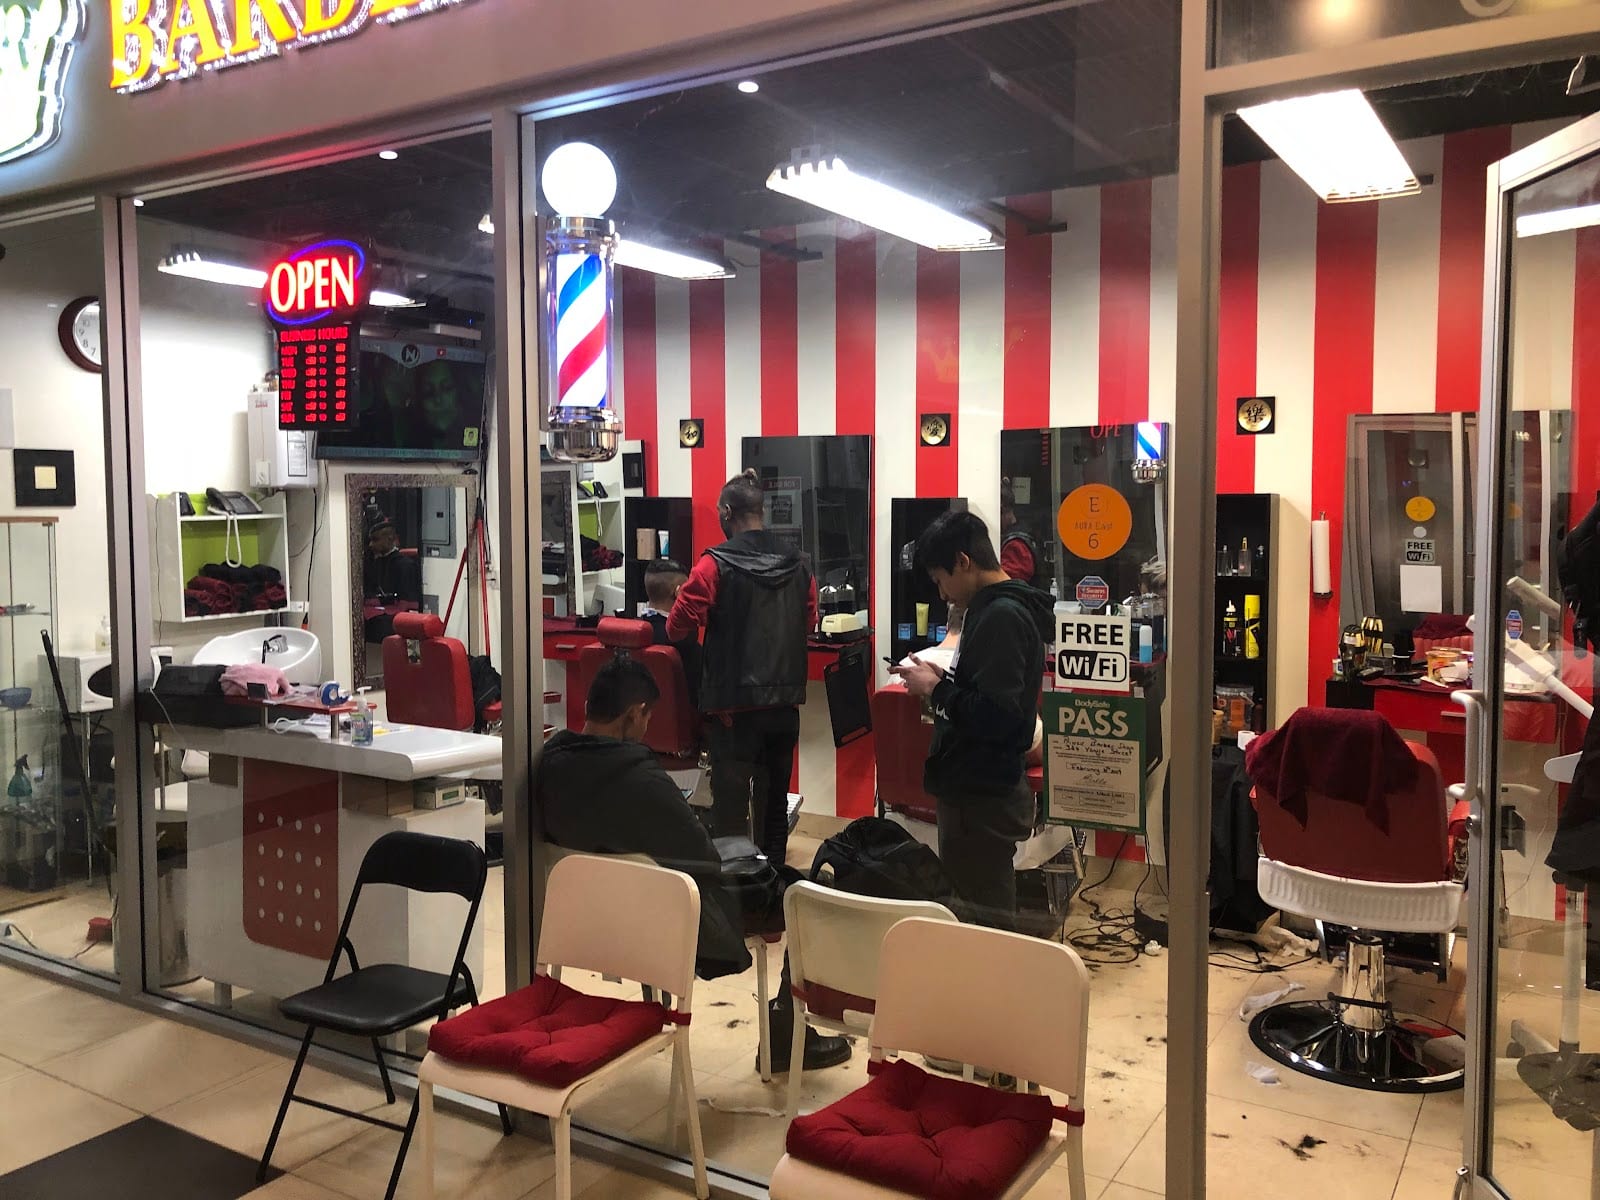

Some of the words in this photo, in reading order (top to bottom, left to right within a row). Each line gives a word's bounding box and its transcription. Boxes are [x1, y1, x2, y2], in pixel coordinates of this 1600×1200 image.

[270, 255, 354, 313] OPEN
[1090, 497, 1099, 512] E
[1088, 534, 1099, 549] 6
[1407, 542, 1432, 550] FREE
[1061, 622, 1124, 646] FREE
[1061, 655, 1118, 678] WiFi
[1058, 706, 1129, 738] PASS
